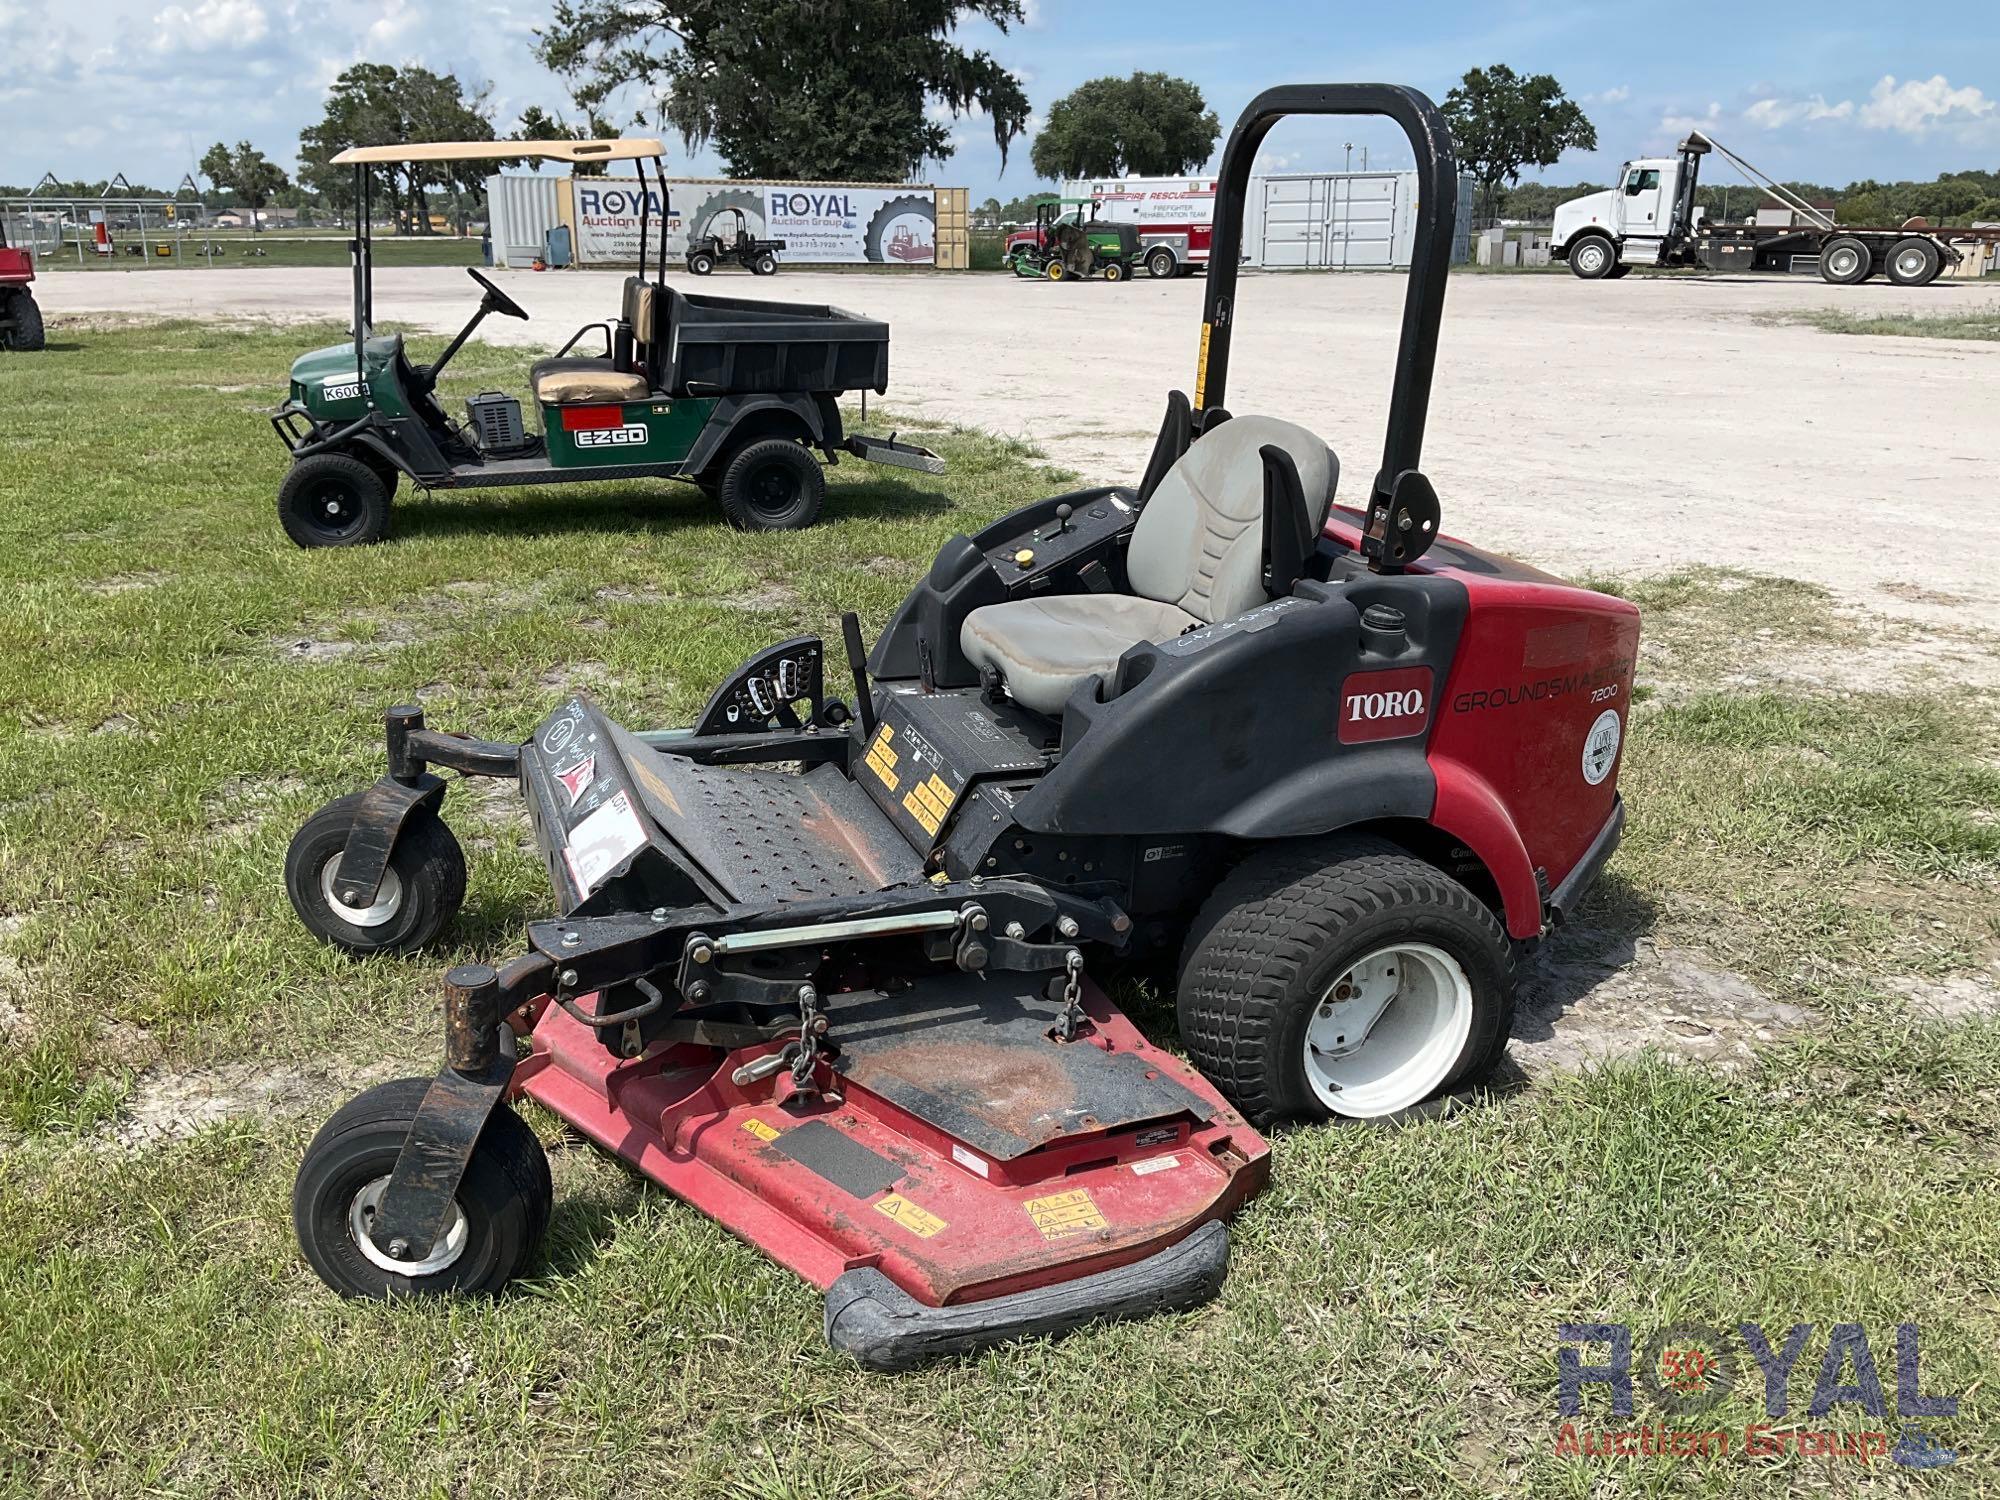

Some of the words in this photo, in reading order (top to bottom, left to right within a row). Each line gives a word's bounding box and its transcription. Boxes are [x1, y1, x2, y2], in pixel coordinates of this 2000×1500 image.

[1126, 192, 1146, 200] FIRE
[1149, 191, 1186, 200] RESCUE
[771, 193, 857, 217] ROYAL
[1154, 204, 1192, 212] FIREFIGHTER
[1140, 211, 1188, 219] REHABILITATION
[582, 216, 634, 227] Auction
[639, 218, 681, 231] roup
[771, 217, 809, 226] Auction
[812, 217, 842, 228] Group
[1589, 683, 1619, 704] 7200
[1346, 689, 1424, 721] TORO
